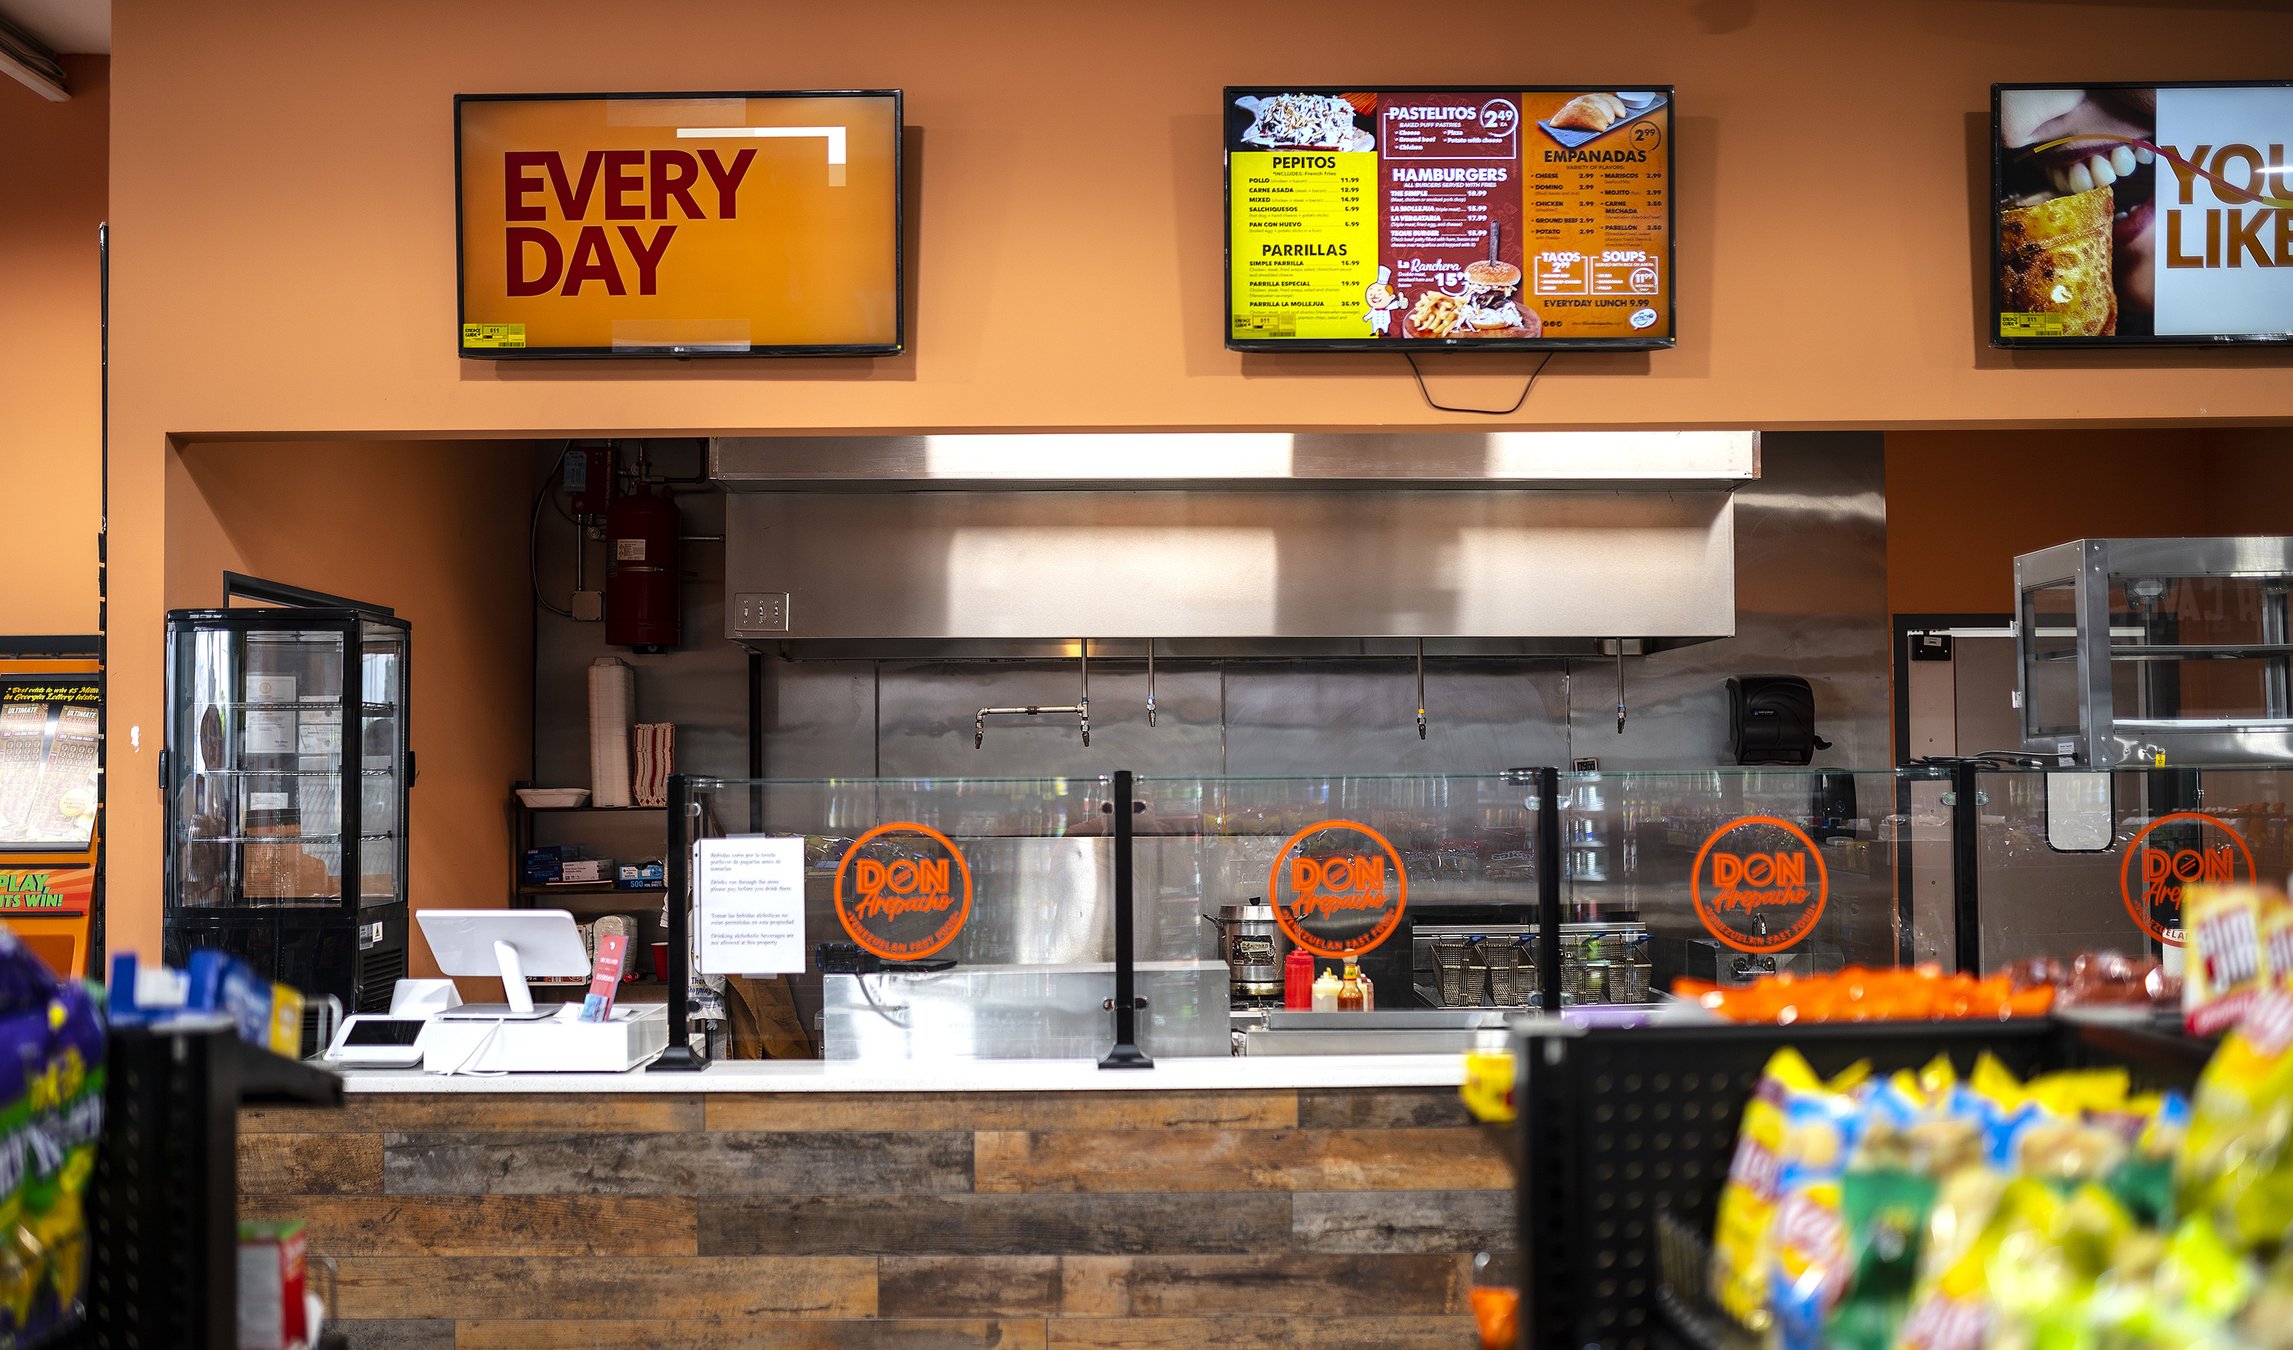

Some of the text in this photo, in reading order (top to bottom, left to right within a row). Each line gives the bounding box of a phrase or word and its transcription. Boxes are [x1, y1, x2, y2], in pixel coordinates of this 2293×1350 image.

[1389, 107, 1476, 120] PASTELITOS
[1273, 157, 1336, 168] PEPITOS
[1544, 150, 1647, 163] EMPANADAS
[504, 149, 758, 221] EVERY
[1392, 168, 1507, 181] HAMBURGERS
[1262, 244, 1347, 256] PARRILLAS
[2166, 208, 2293, 268] LIKE
[506, 226, 678, 297] DAY
[1397, 260, 1410, 268] La
[1411, 258, 1461, 272] Ranchera
[1542, 252, 1581, 262] TACOS
[1602, 251, 1646, 262] SOUPS
[67, 710, 96, 718] ULTIMATE
[856, 859, 949, 894] DON
[1291, 856, 1384, 892] DON
[1712, 852, 1805, 888] DON
[2142, 849, 2234, 882] DON
[24, 894, 64, 908] WIN!
[855, 890, 955, 922] Arepacho
[1290, 887, 1390, 921] Arepacho
[1712, 883, 1811, 916] Arepacho
[2142, 881, 2189, 910] Arep
[848, 916, 908, 953] VENEZUELAN
[910, 935, 934, 951] FAST
[1284, 914, 1343, 951] VENEZUELAN
[1345, 933, 1370, 949] FAST
[1707, 908, 1764, 945] VENEZUELAN
[1766, 930, 1791, 944] FAST
